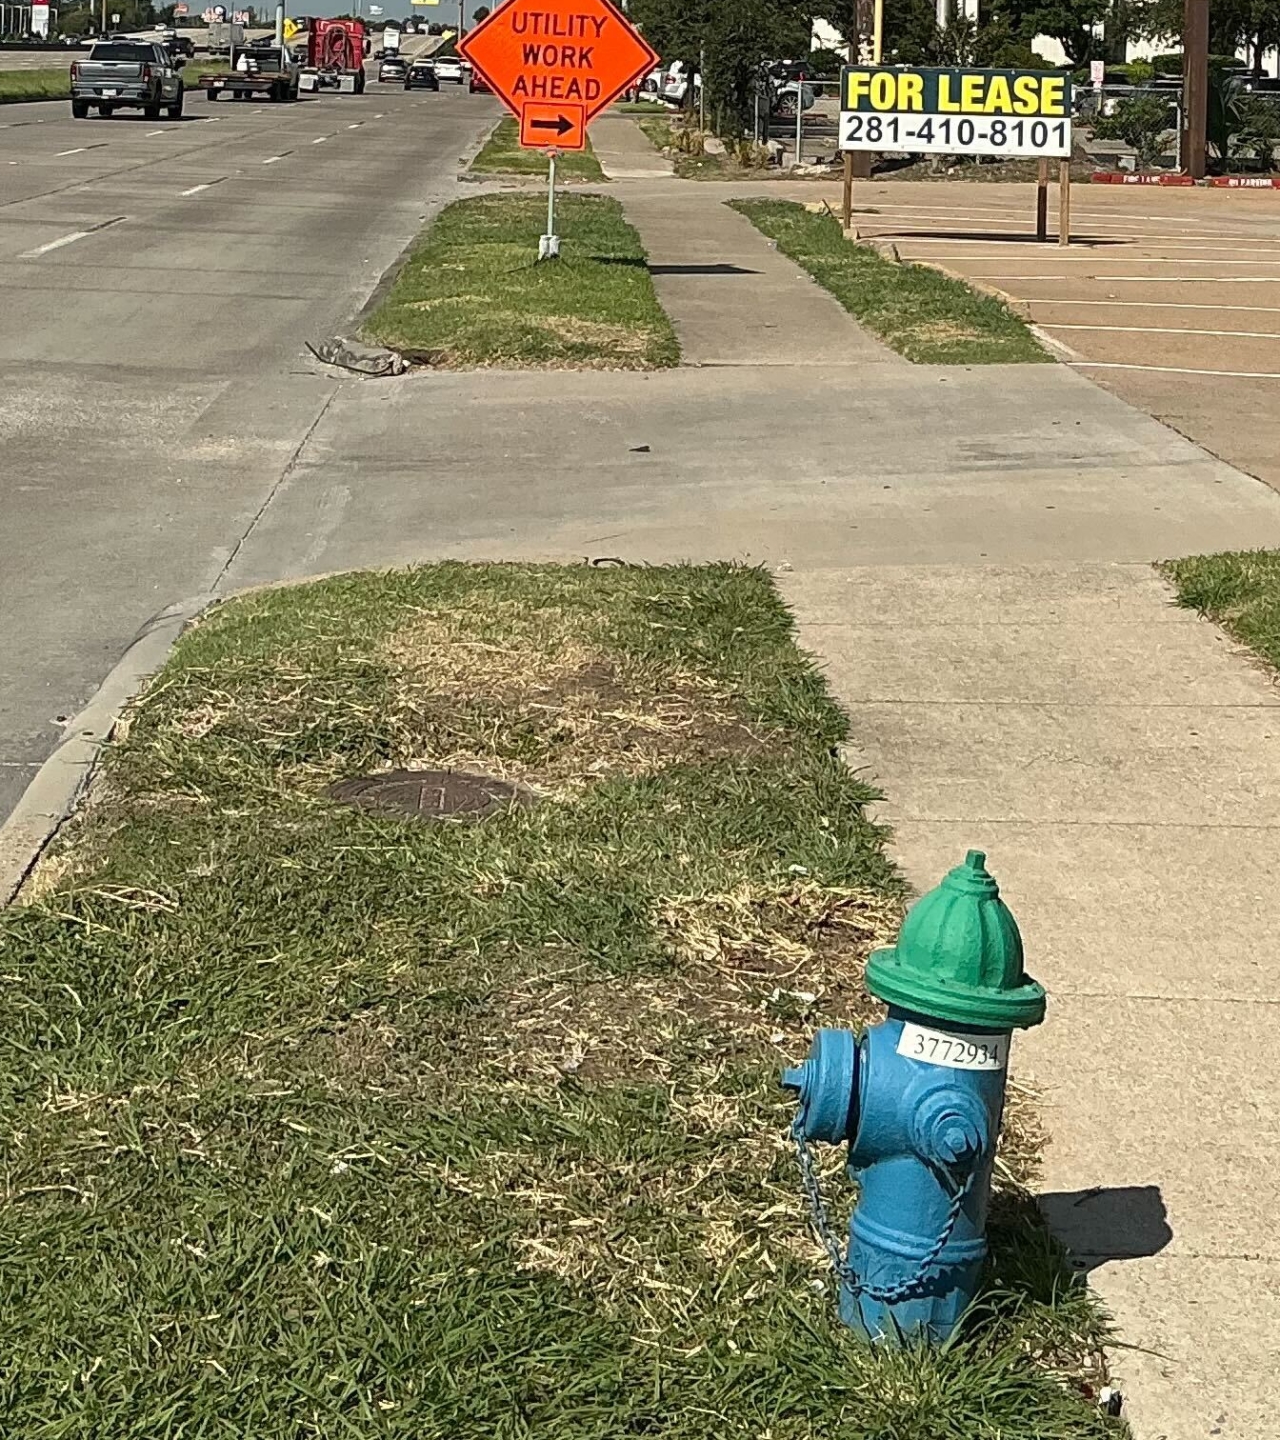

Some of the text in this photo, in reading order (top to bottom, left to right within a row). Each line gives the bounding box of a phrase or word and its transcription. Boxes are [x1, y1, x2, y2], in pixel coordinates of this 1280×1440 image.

[511, 12, 608, 38] UTILITY
[522, 43, 595, 69] WORK
[511, 74, 601, 100] AHEAD
[847, 71, 1066, 116] FOR LEASE
[845, 114, 1066, 149] 281-410-8101
[914, 1033, 999, 1066] 3772934
